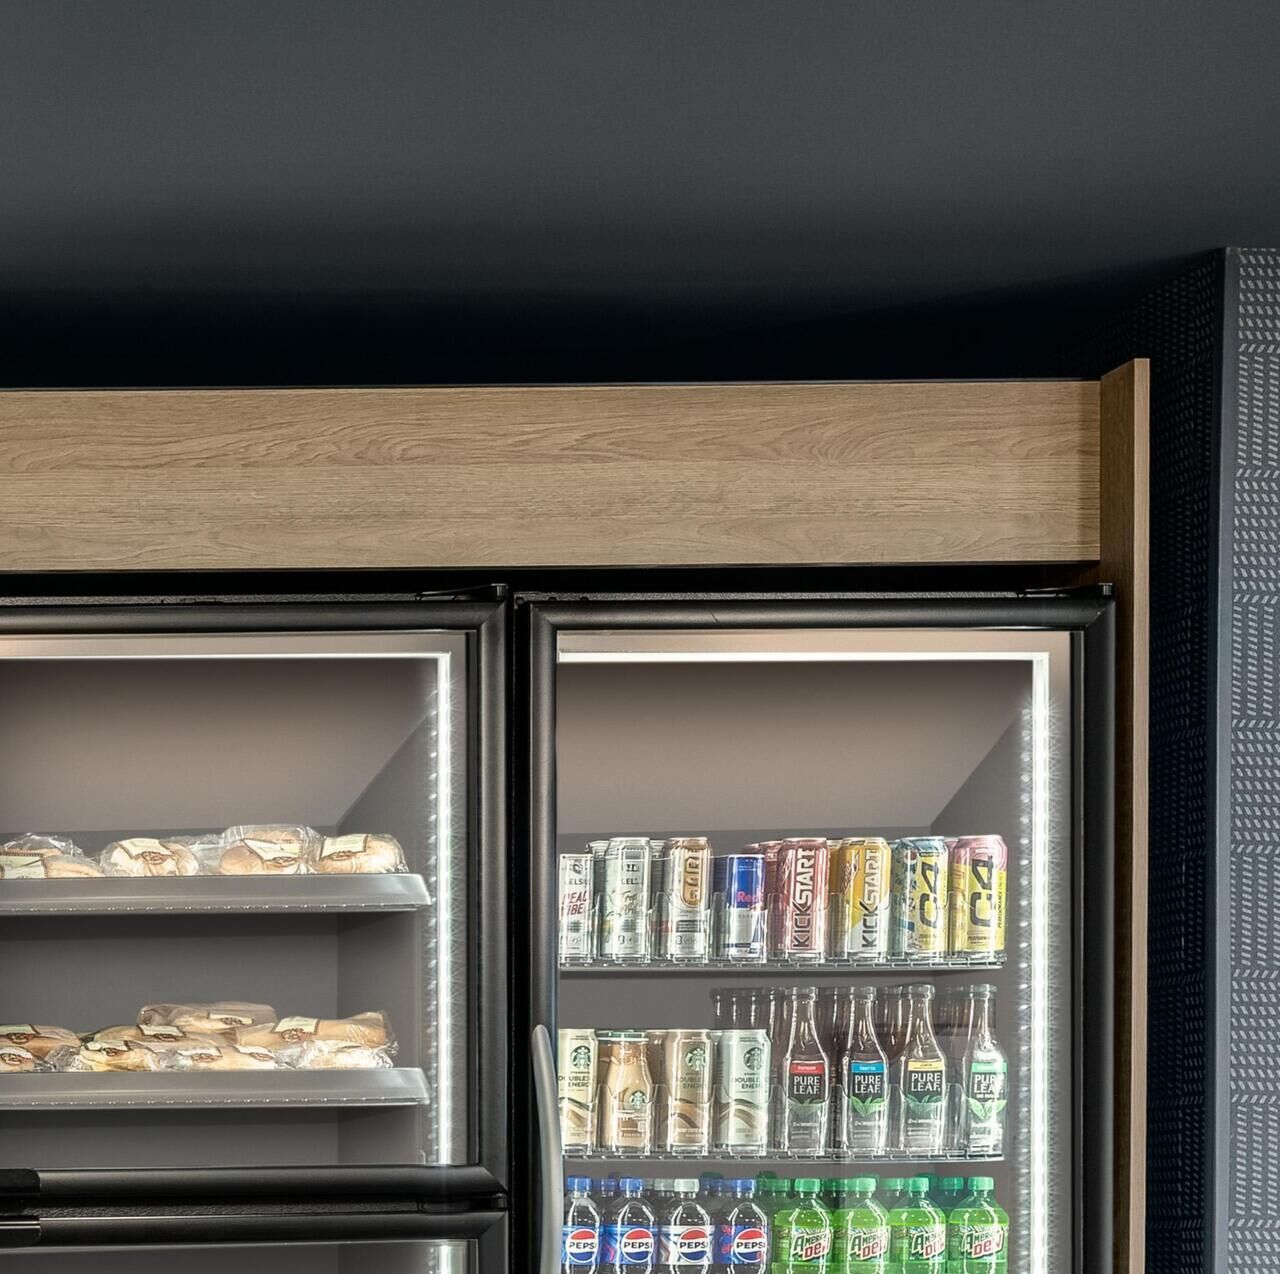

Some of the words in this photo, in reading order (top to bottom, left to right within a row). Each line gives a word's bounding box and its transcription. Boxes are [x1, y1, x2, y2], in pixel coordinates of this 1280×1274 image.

[919, 860, 940, 929] C4
[970, 854, 995, 928] C4
[794, 1076, 820, 1085] PURE
[855, 1075, 881, 1084] PURE
[911, 1073, 940, 1082] PURE
[624, 1241, 653, 1249] PEPSI
[679, 1241, 708, 1249] PEPSI
[736, 1241, 766, 1249] PEPSI
